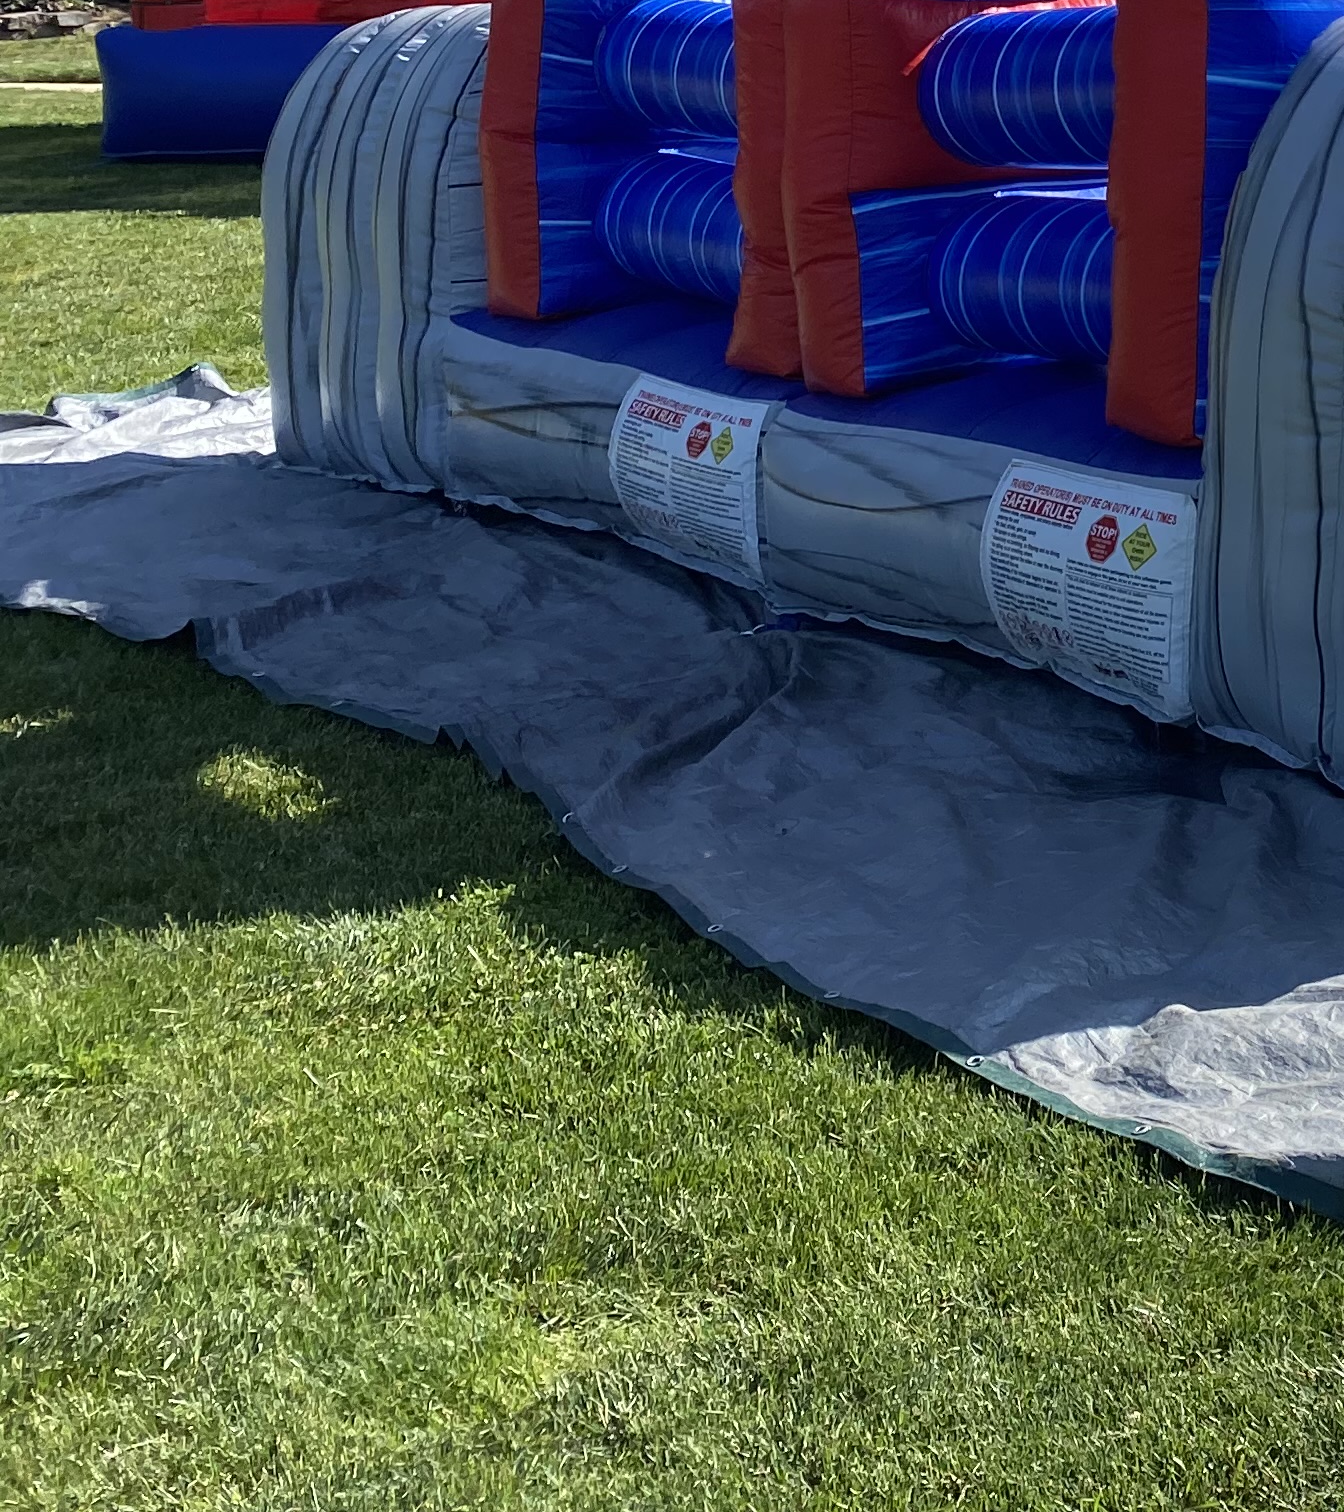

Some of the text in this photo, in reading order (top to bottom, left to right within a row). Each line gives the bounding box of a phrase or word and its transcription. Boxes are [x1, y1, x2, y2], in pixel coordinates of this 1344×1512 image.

[629, 401, 660, 422] SAFETY
[658, 410, 685, 426] RULES
[1001, 491, 1044, 513] SAFETY
[1041, 500, 1081, 524] RULES
[1090, 497, 1102, 508] BE
[1101, 500, 1113, 512] ON
[1112, 502, 1131, 516] DUTY
[1128, 506, 1142, 518] AT
[1140, 509, 1154, 521] ALL
[1155, 512, 1177, 526] TIMES
[1090, 524, 1117, 541] STOP!
